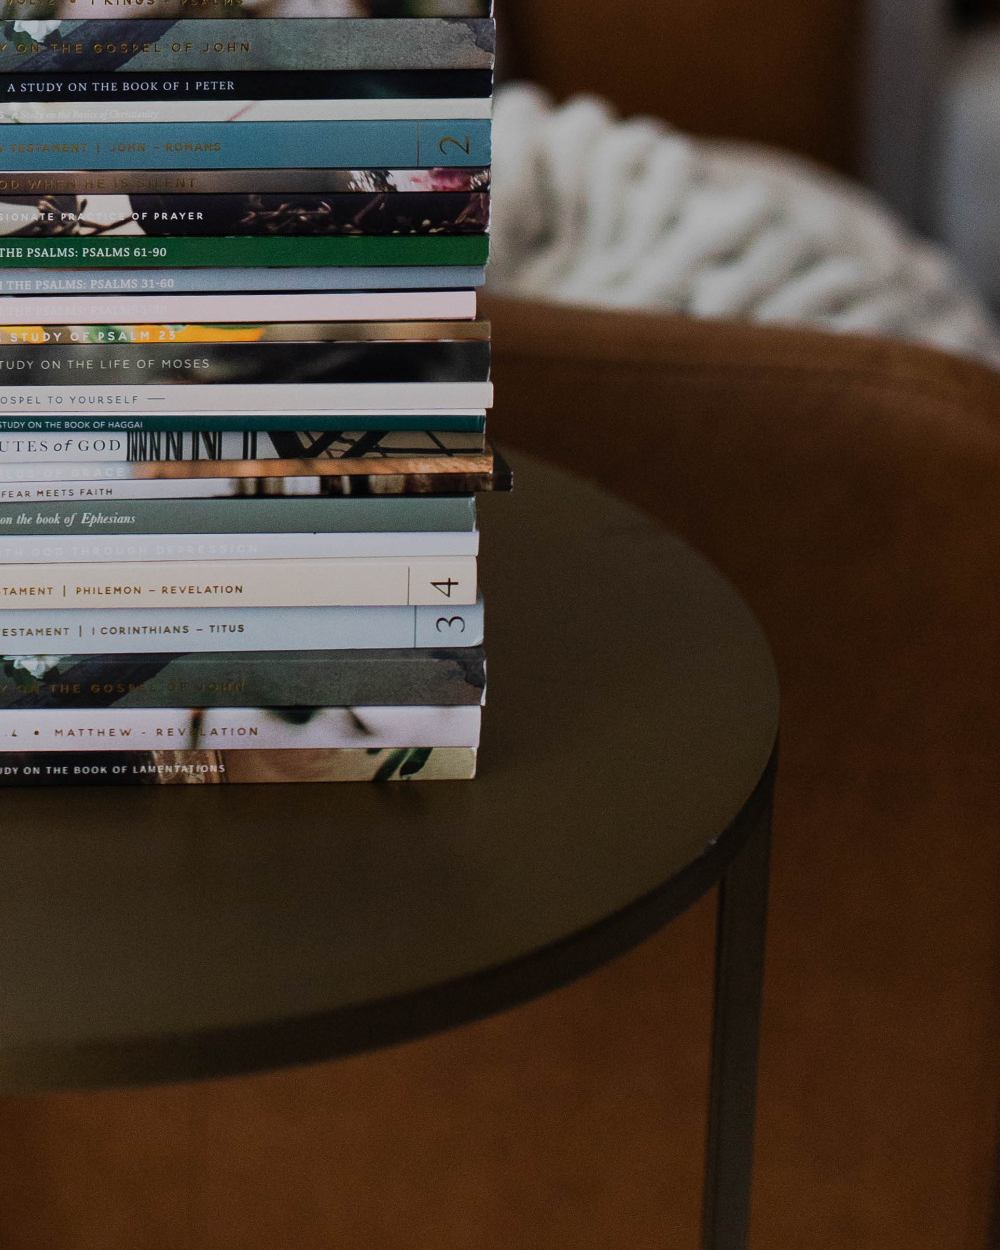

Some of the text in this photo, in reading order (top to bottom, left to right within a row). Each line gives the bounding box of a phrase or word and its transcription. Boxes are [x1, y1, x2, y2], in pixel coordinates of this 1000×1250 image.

[7, 83, 15, 92] A
[20, 82, 63, 92] STUDY
[68, 82, 88, 92] ON
[92, 82, 118, 92] THE
[122, 81, 158, 91] BOOK
[163, 81, 180, 91] OF
[185, 81, 189, 91] 1
[195, 81, 235, 91] PETER
[27, 248, 78, 257] PSALMS:
[82, 248, 130, 257] PSALMS
[133, 248, 167, 257] 61-90
[40, 360, 61, 369] ON
[67, 360, 93, 369] THE
[100, 359, 130, 369] LIFE
[136, 359, 155, 369] OF
[161, 358, 210, 368] MOSES
[48, 396, 63, 404] TO
[69, 396, 139, 404] YOURSELF
[53, 440, 73, 451] of
[78, 439, 121, 451] GOD
[1, 490, 31, 498] FEAR
[37, 489, 74, 497] MEETS
[80, 489, 113, 497] FAITH
[0, 516, 13, 524] on
[16, 512, 33, 525] the
[35, 512, 60, 524] book
[63, 513, 78, 526] of
[81, 512, 136, 526] Ephesians
[75, 586, 142, 595] PHILEMON
[161, 585, 243, 594] REVELATION
[430, 577, 459, 597] 4
[436, 615, 465, 632] 3
[100, 626, 189, 635] CORINTHIANS
[209, 625, 245, 633] TITUS
[54, 728, 132, 737] MATTHEW
[156, 727, 259, 736] REVELATION
[23, 766, 41, 775] ON
[46, 766, 69, 774] THE
[73, 765, 107, 774] BOOK
[112, 765, 128, 774] OF
[133, 764, 226, 774] LAMENTATIONS
